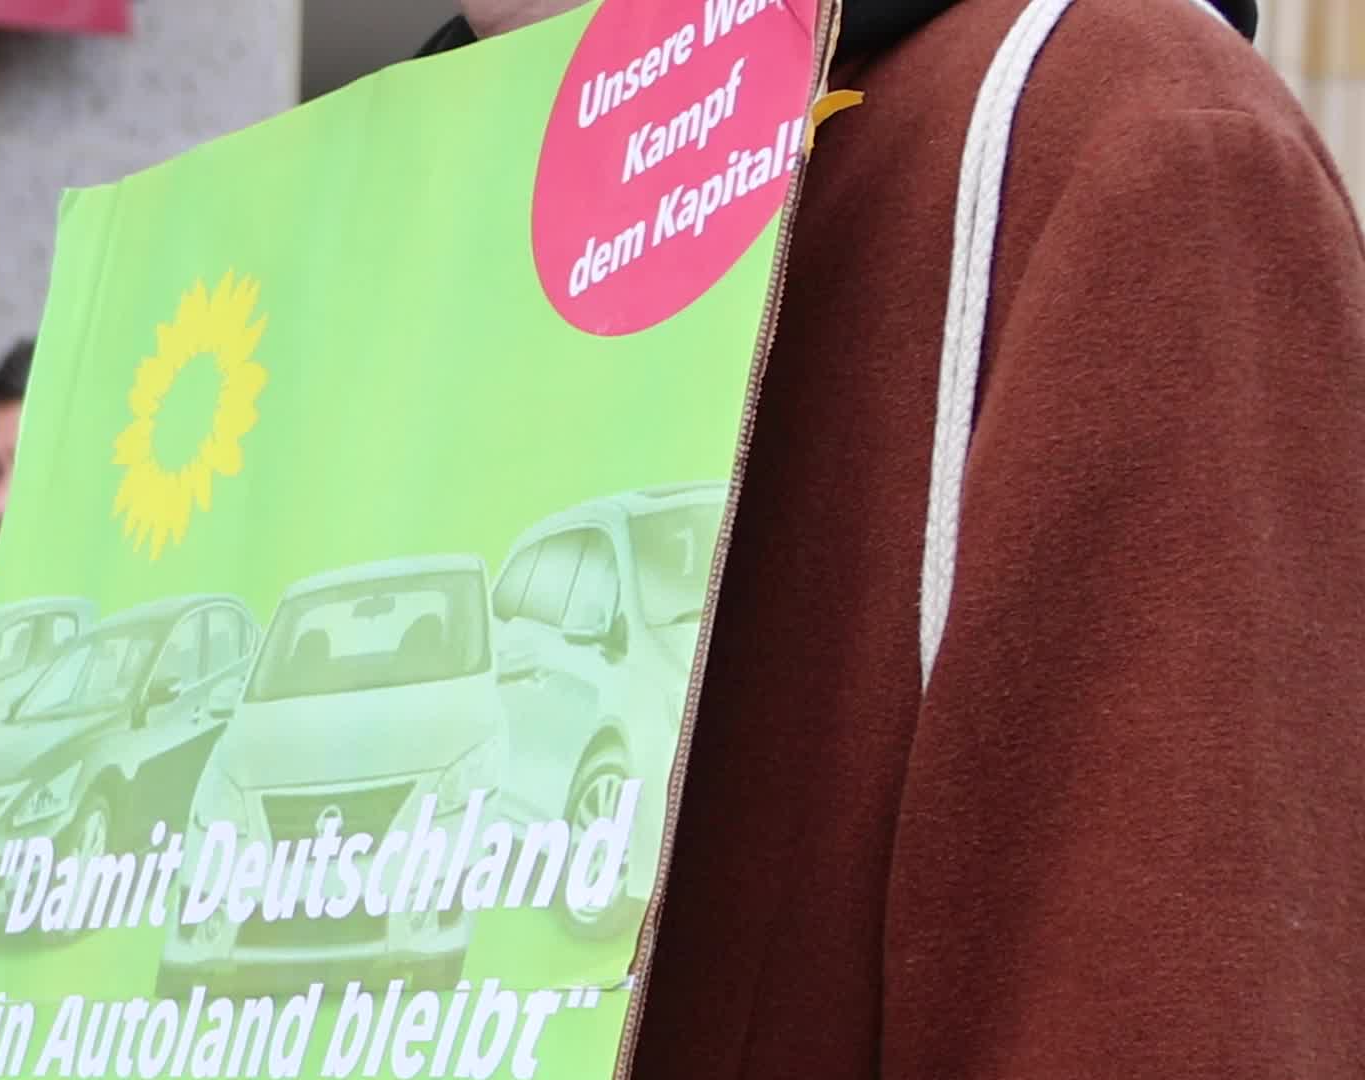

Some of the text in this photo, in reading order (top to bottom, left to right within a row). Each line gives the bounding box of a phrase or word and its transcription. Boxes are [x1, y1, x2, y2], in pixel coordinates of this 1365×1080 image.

[577, 23, 696, 129] Unsere
[621, 55, 747, 184] Kampf
[568, 116, 806, 297] dem Kapital!
[180, 779, 643, 925] Deutschland
[31, 981, 325, 1080] Autoland
